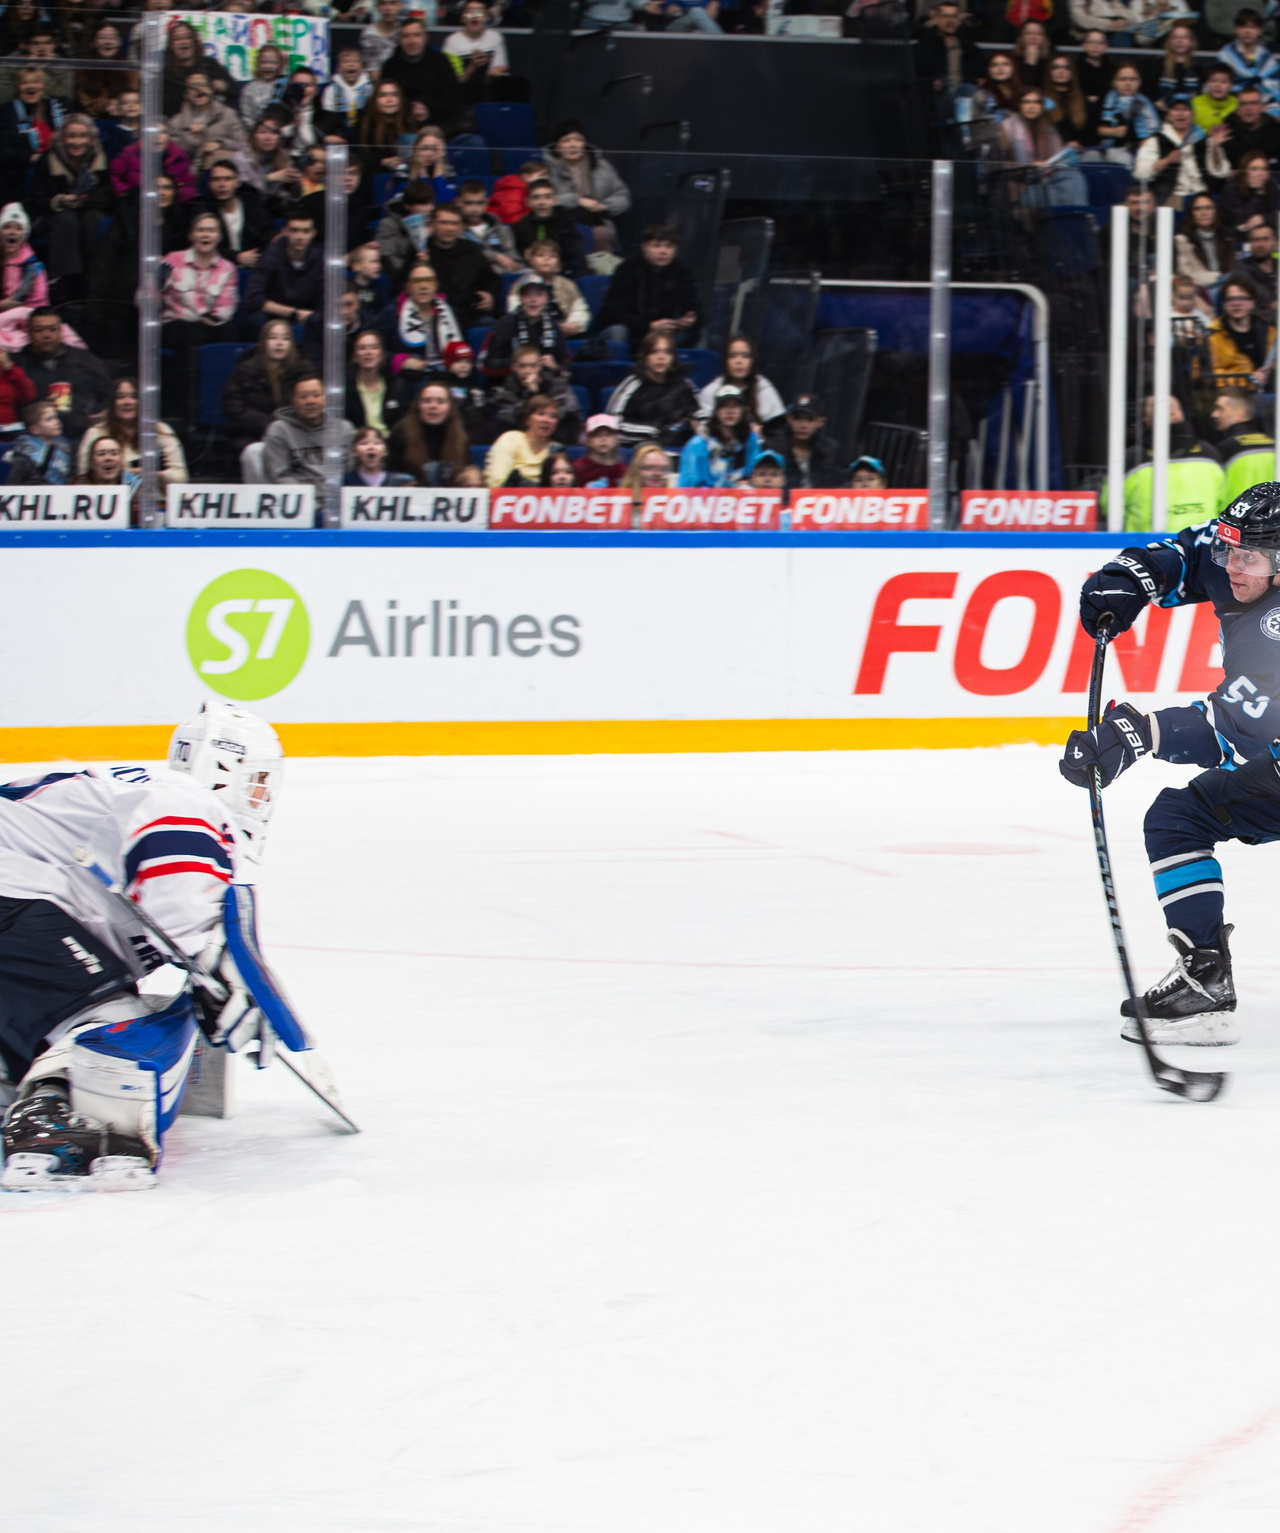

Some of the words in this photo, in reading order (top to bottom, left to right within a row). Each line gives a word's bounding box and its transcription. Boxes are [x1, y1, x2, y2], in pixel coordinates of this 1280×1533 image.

[178, 493, 304, 519] KHL.RU
[352, 495, 479, 522] KHL.RU
[491, 495, 632, 524] FONBET
[641, 495, 781, 524] FONBET
[792, 496, 927, 524] FONBET
[963, 498, 1095, 526] FONBET
[1230, 501, 1251, 518] 53
[199, 598, 296, 676] S7
[327, 599, 582, 659] Airlines
